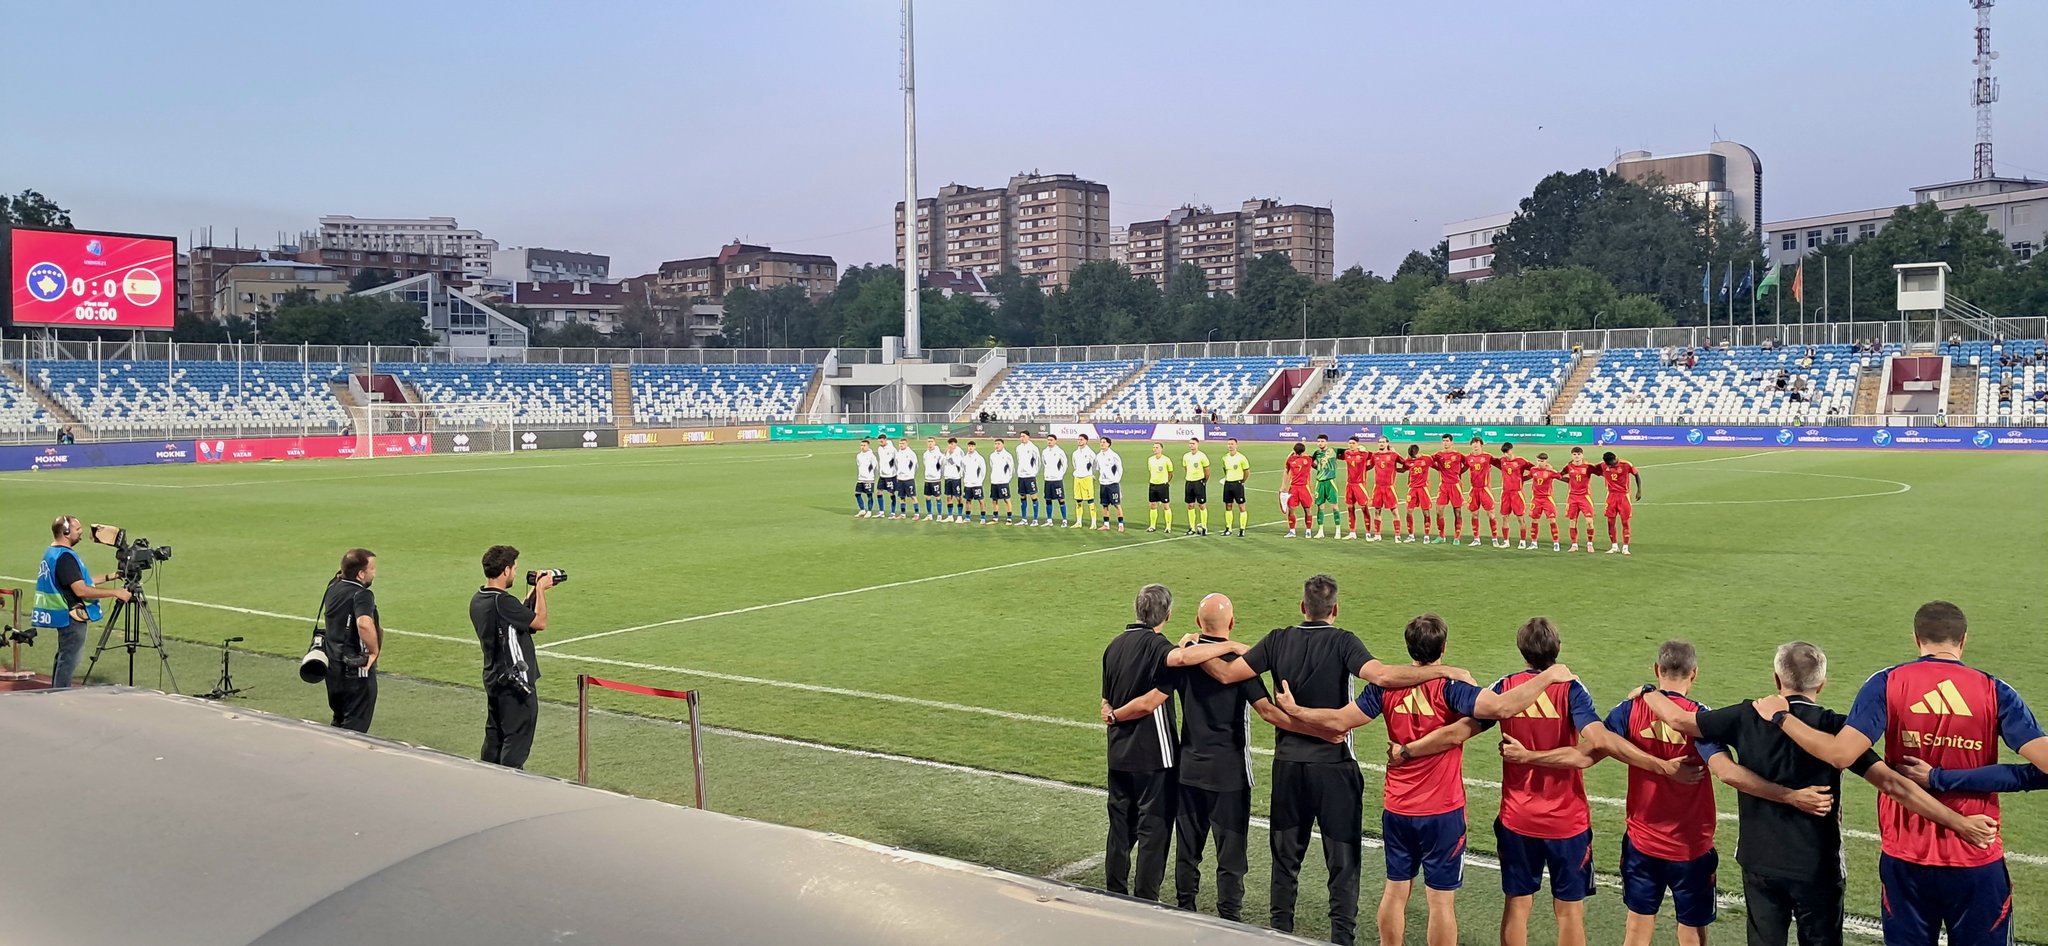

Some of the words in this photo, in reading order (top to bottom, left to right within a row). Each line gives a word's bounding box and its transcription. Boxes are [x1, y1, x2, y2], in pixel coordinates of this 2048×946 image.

[75, 306, 117, 321] 00:00
[623, 433, 657, 444] #FOOTBALL
[682, 431, 714, 442] #FOOTBALL
[35, 455, 68, 463] MOKNE
[156, 450, 186, 458] MOKNE
[1923, 733, 1983, 751] Sanitas
